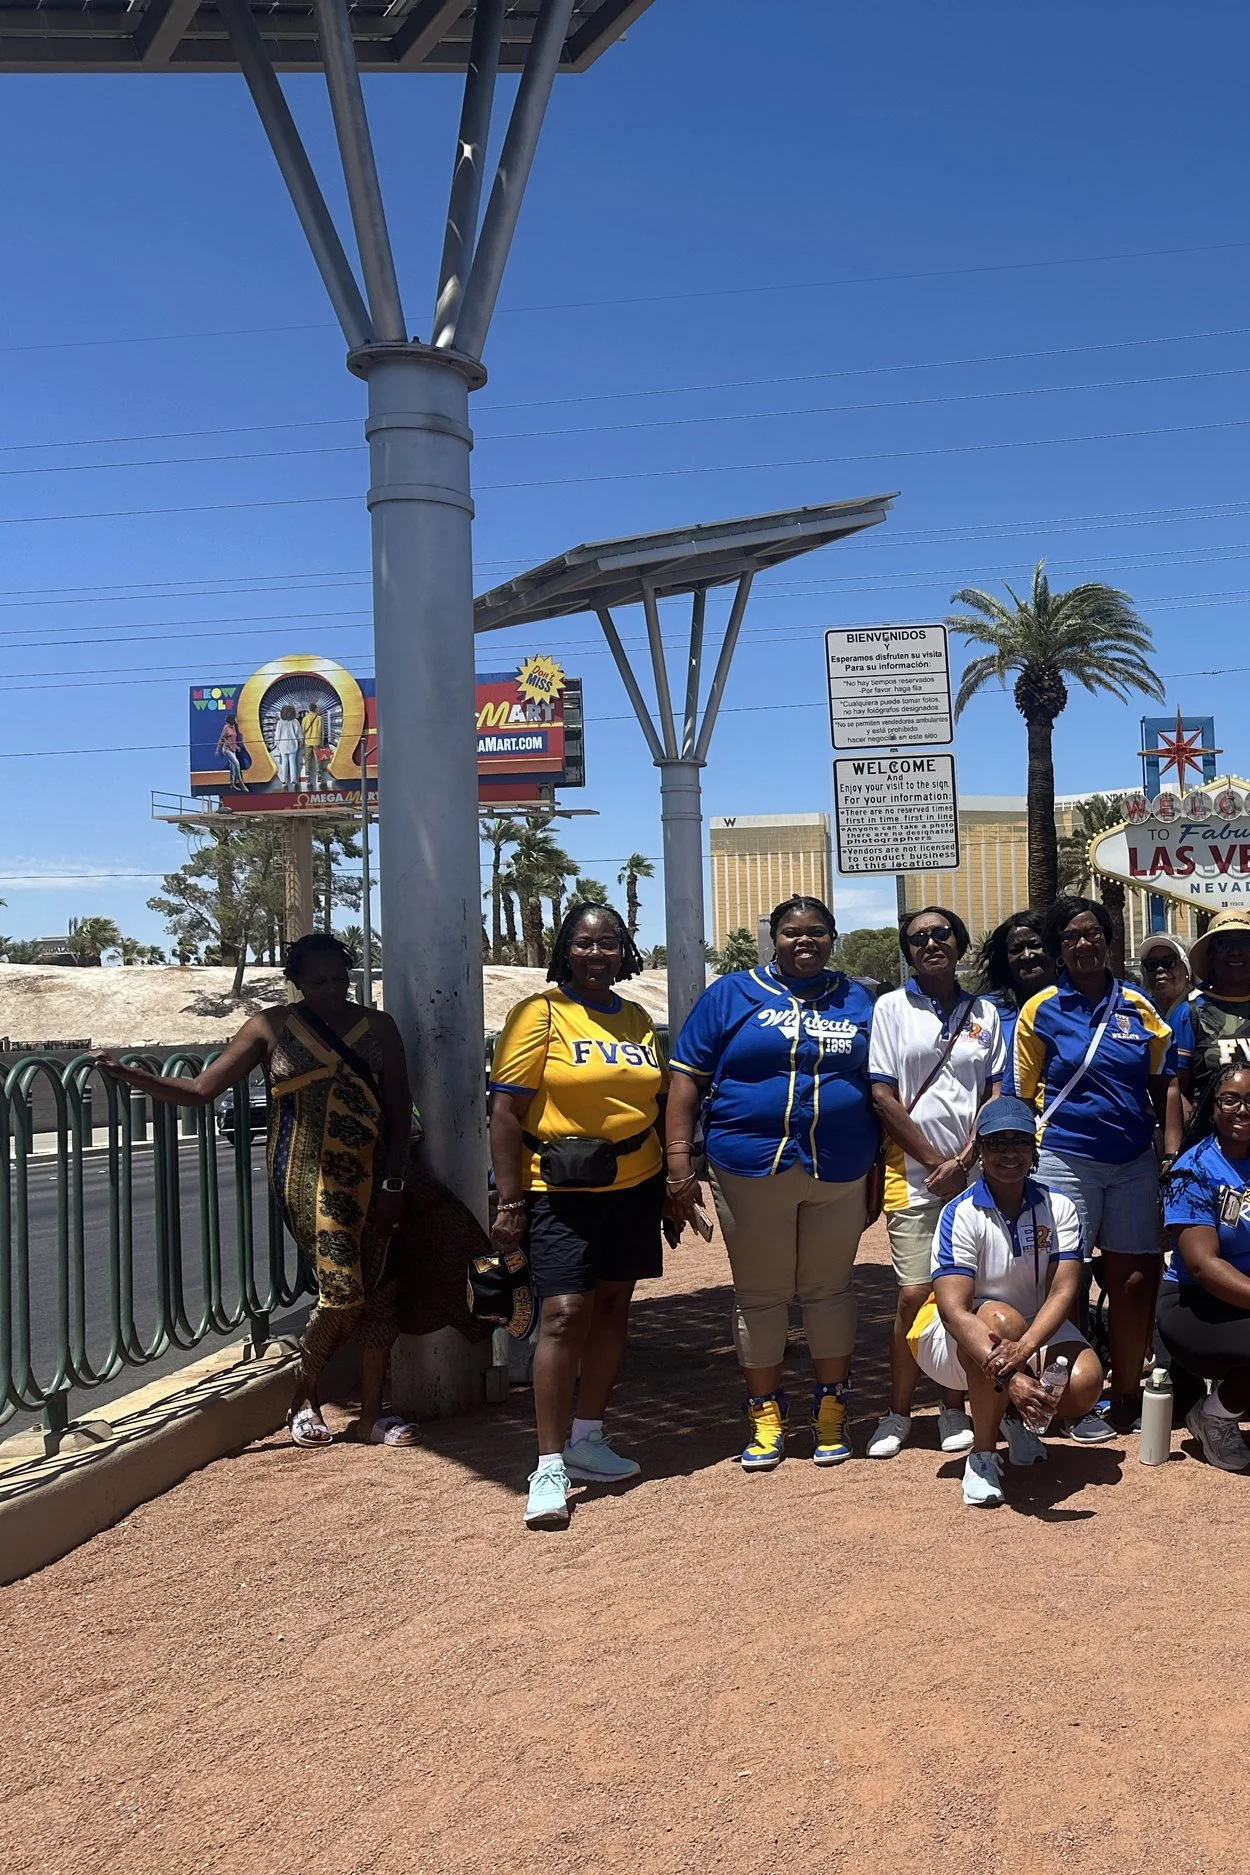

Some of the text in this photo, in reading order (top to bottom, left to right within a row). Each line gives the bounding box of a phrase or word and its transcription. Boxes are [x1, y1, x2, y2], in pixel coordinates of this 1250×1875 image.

[846, 630, 926, 643] BIENVENIDOS
[831, 655, 873, 664] Esperamos
[876, 652, 909, 660] disfruten
[845, 664, 864, 672] Para
[879, 661, 931, 670] información:
[532, 665, 555, 681] Don't
[526, 673, 552, 692] MISS
[857, 679, 869, 687] hay
[871, 678, 897, 686] tiempos
[193, 688, 236, 699] MEOW
[894, 685, 911, 693] haga
[880, 699, 900, 707] puede
[902, 697, 921, 705] tomar
[476, 701, 555, 727] MART
[853, 708, 865, 716] hay
[867, 706, 899, 714] fotógrafos
[901, 704, 938, 712] designados
[856, 720, 880, 728] permiten
[916, 716, 948, 724] ambulantes
[888, 726, 918, 735] prohibido
[477, 736, 542, 753] AMART.COM
[868, 734, 897, 743] negocis
[852, 759, 936, 775] WELCOME
[840, 783, 862, 794] Enjoy
[865, 783, 883, 794] your
[886, 781, 903, 790] visit
[906, 781, 914, 789] to
[917, 780, 929, 789] the
[844, 792, 952, 805] For your information:
[897, 806, 929, 814] reserved
[724, 818, 736, 827] W
[847, 835, 932, 845] photographers
[1148, 828, 1170, 840] TO
[848, 847, 882, 855] Vendors
[862, 854, 905, 862] conduct
[910, 852, 955, 860] business
[1128, 846, 1196, 877] LAS
[826, 1038, 852, 1054] 1895
[572, 1040, 660, 1070] FVSU
